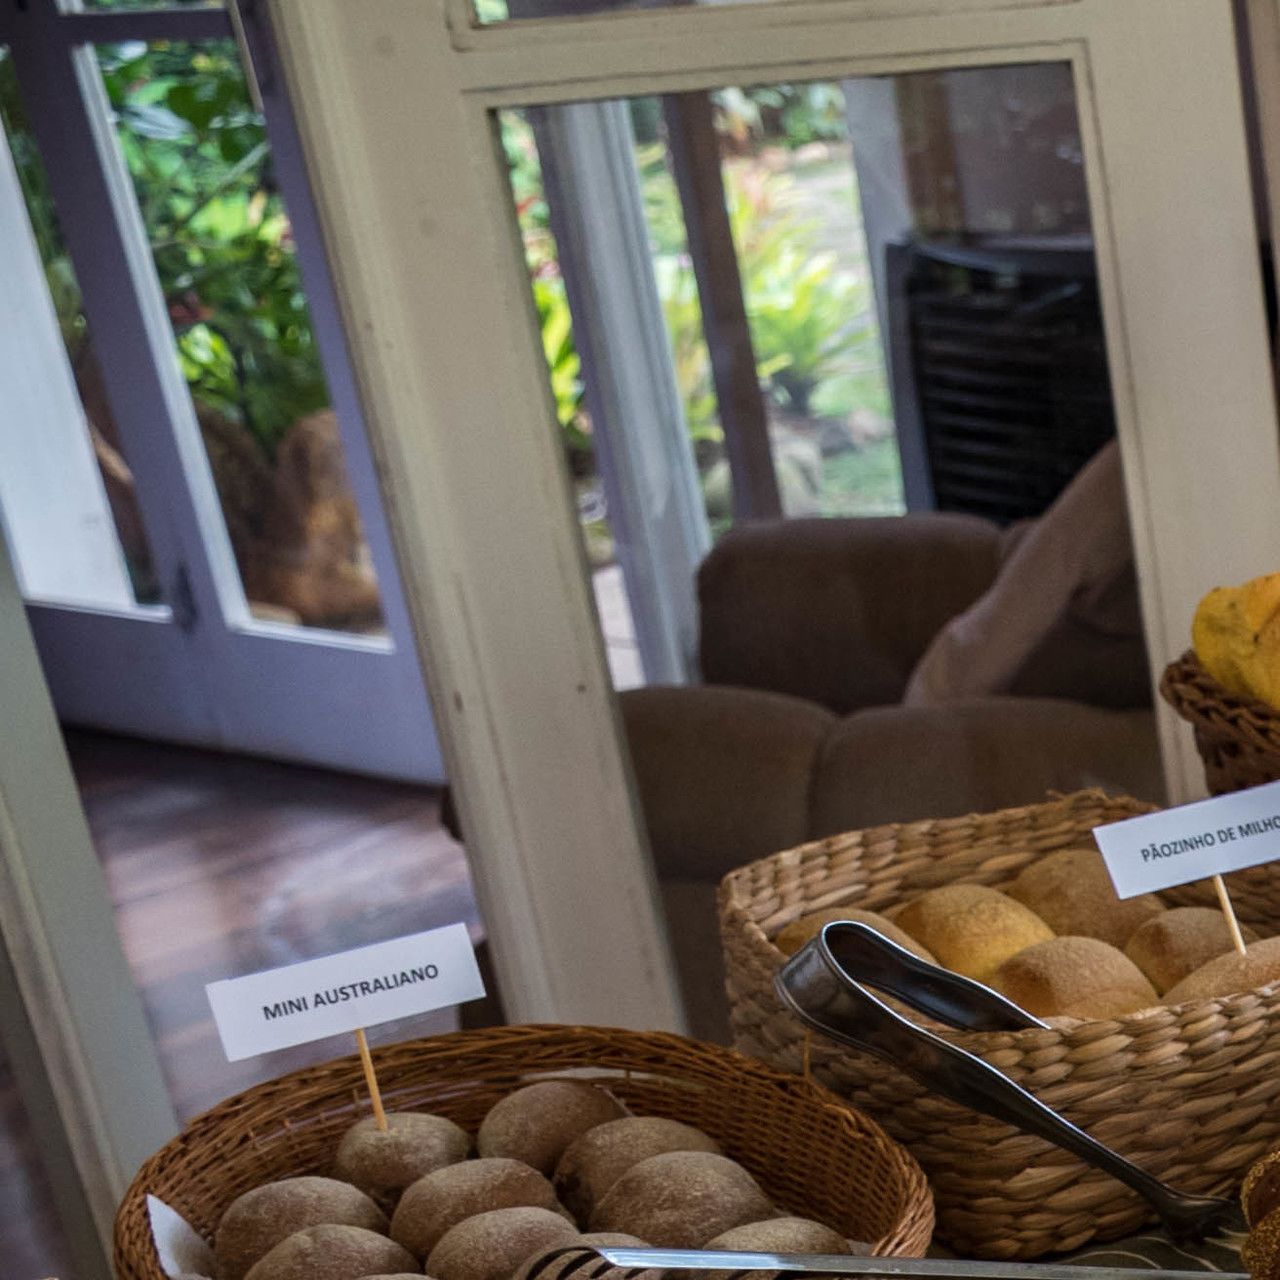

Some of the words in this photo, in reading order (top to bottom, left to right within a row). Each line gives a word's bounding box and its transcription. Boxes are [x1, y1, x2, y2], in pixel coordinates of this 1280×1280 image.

[1140, 833, 1216, 863] PÃOZINHO
[1217, 827, 1236, 844] DE
[263, 997, 309, 1020] MINI
[313, 963, 439, 1008] AUSTRALIANO
